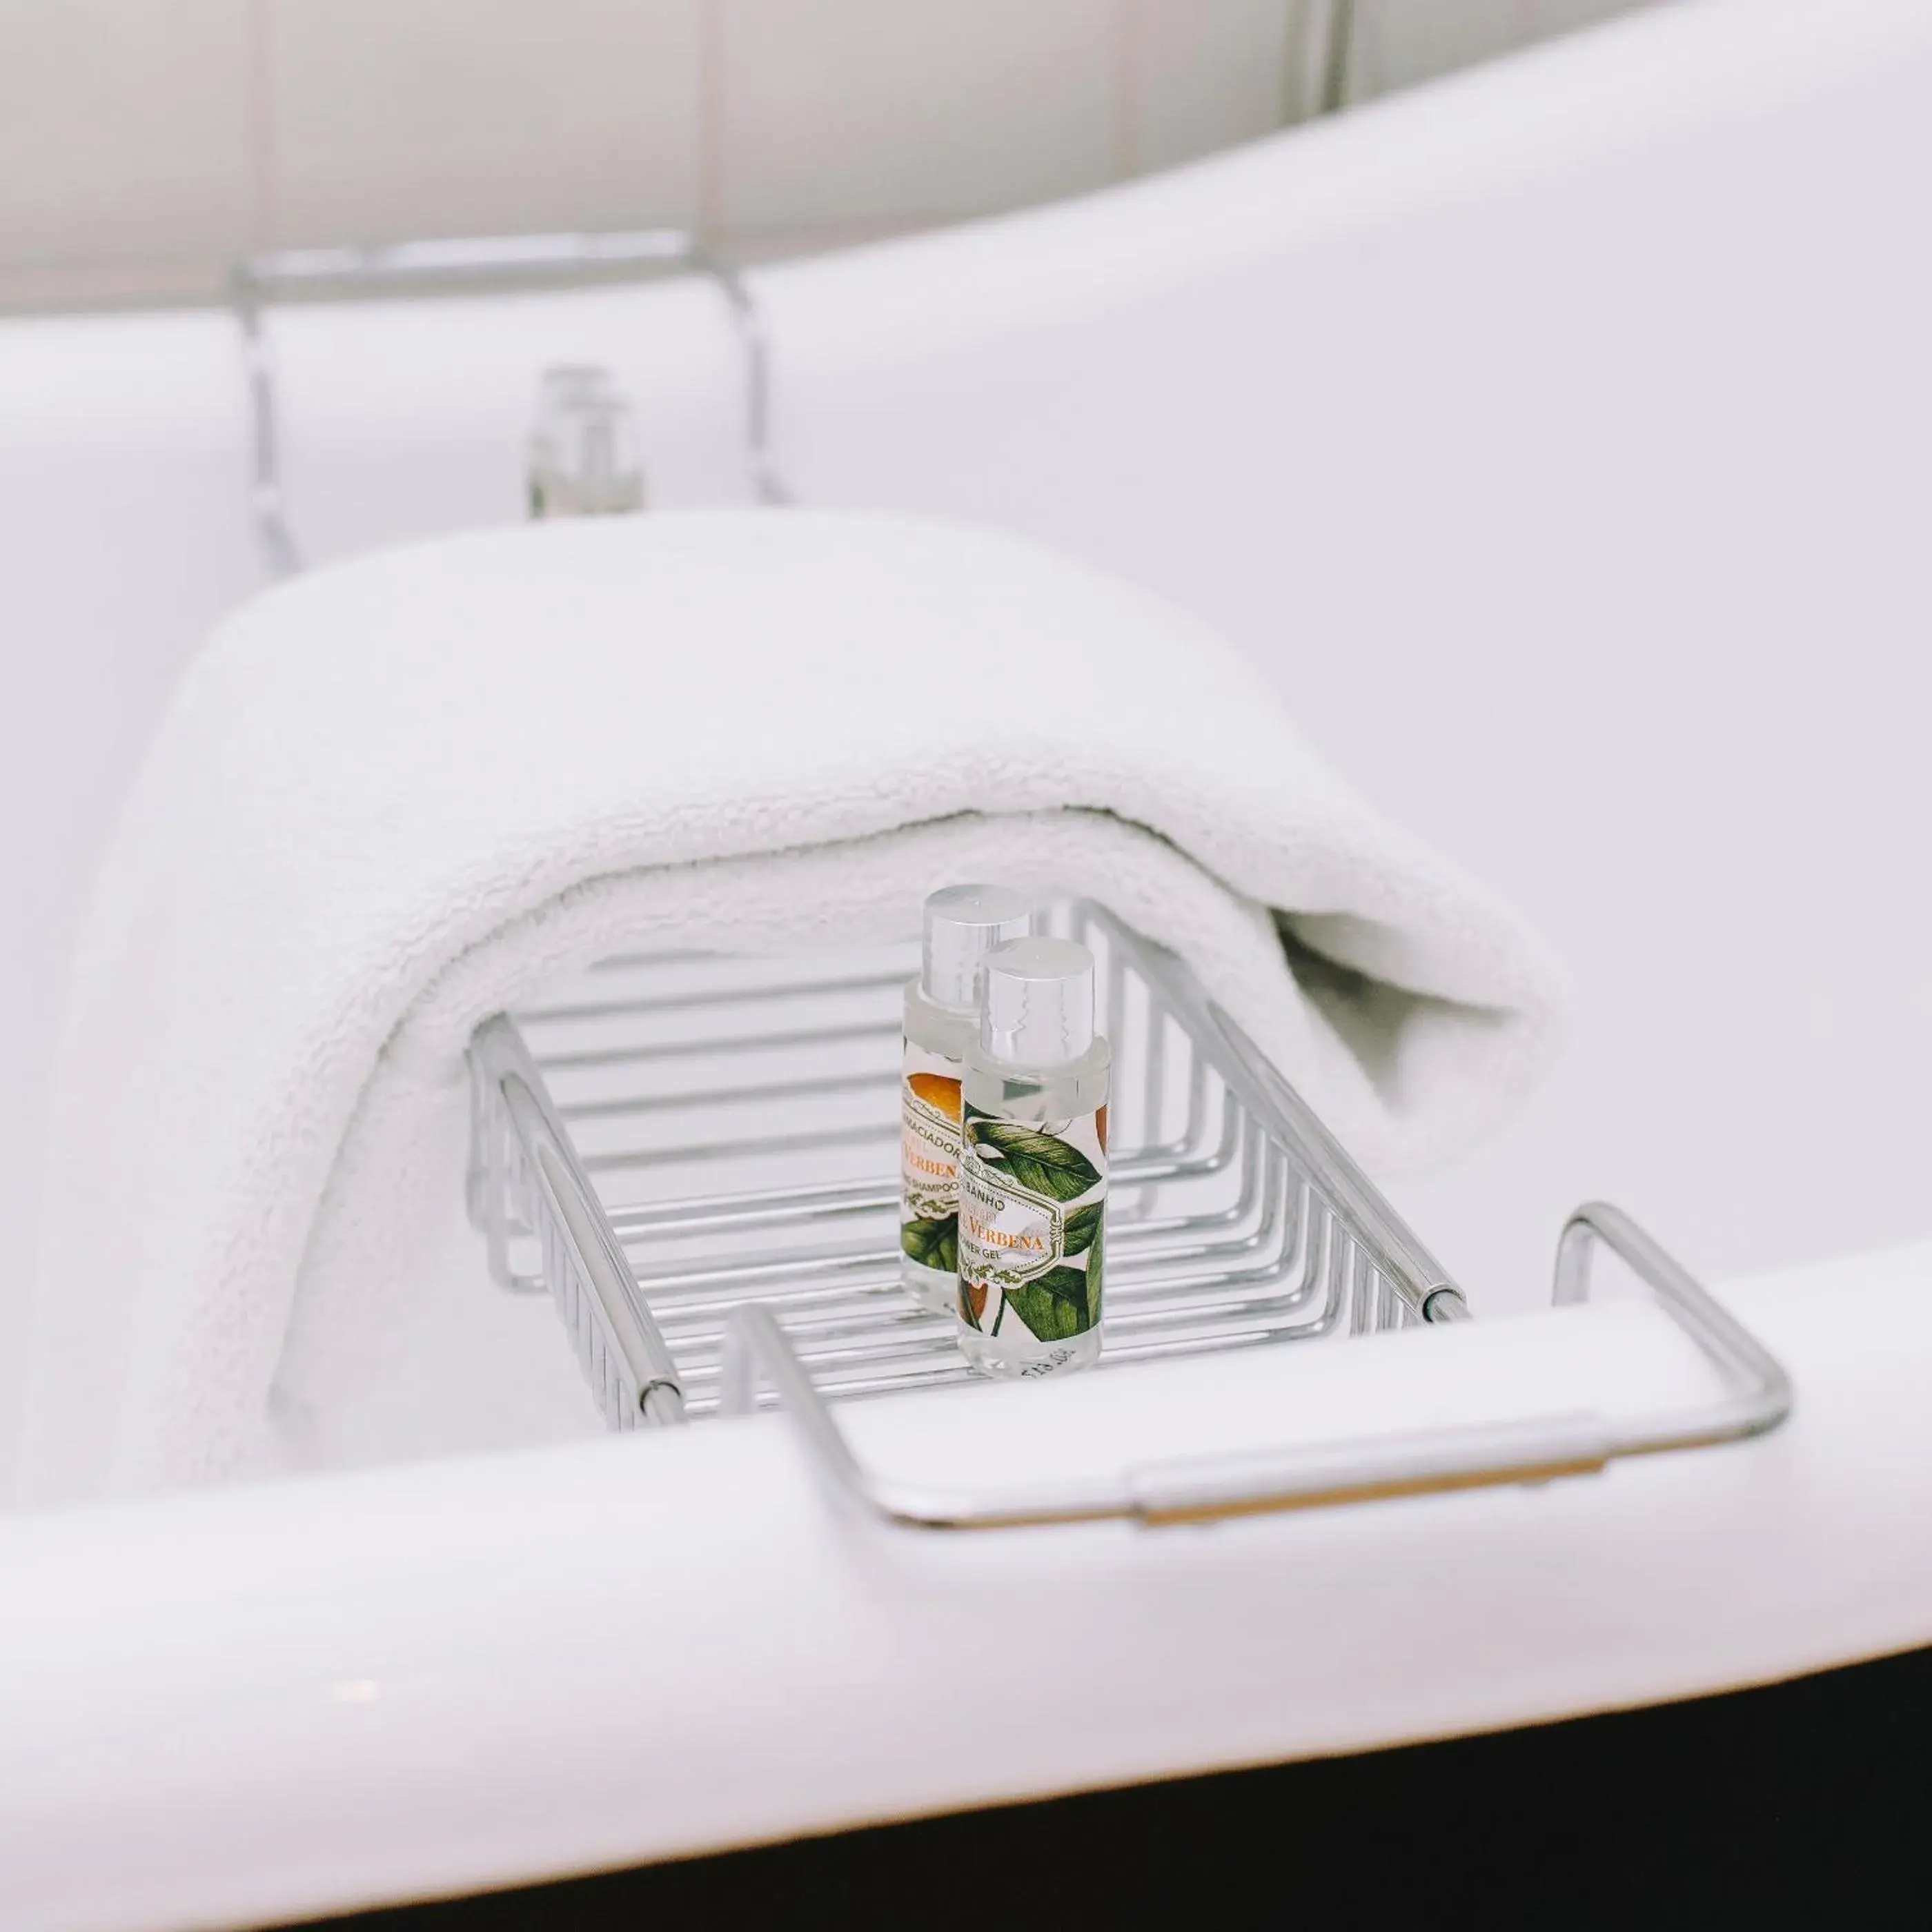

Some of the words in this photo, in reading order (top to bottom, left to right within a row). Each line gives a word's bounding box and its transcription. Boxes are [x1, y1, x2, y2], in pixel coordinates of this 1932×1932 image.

[905, 1141, 958, 1179] VERBEN
[912, 1179, 959, 1192] SHAMPOO
[969, 1215, 1045, 1250] VERBENA
[982, 1248, 1001, 1259] GEL
